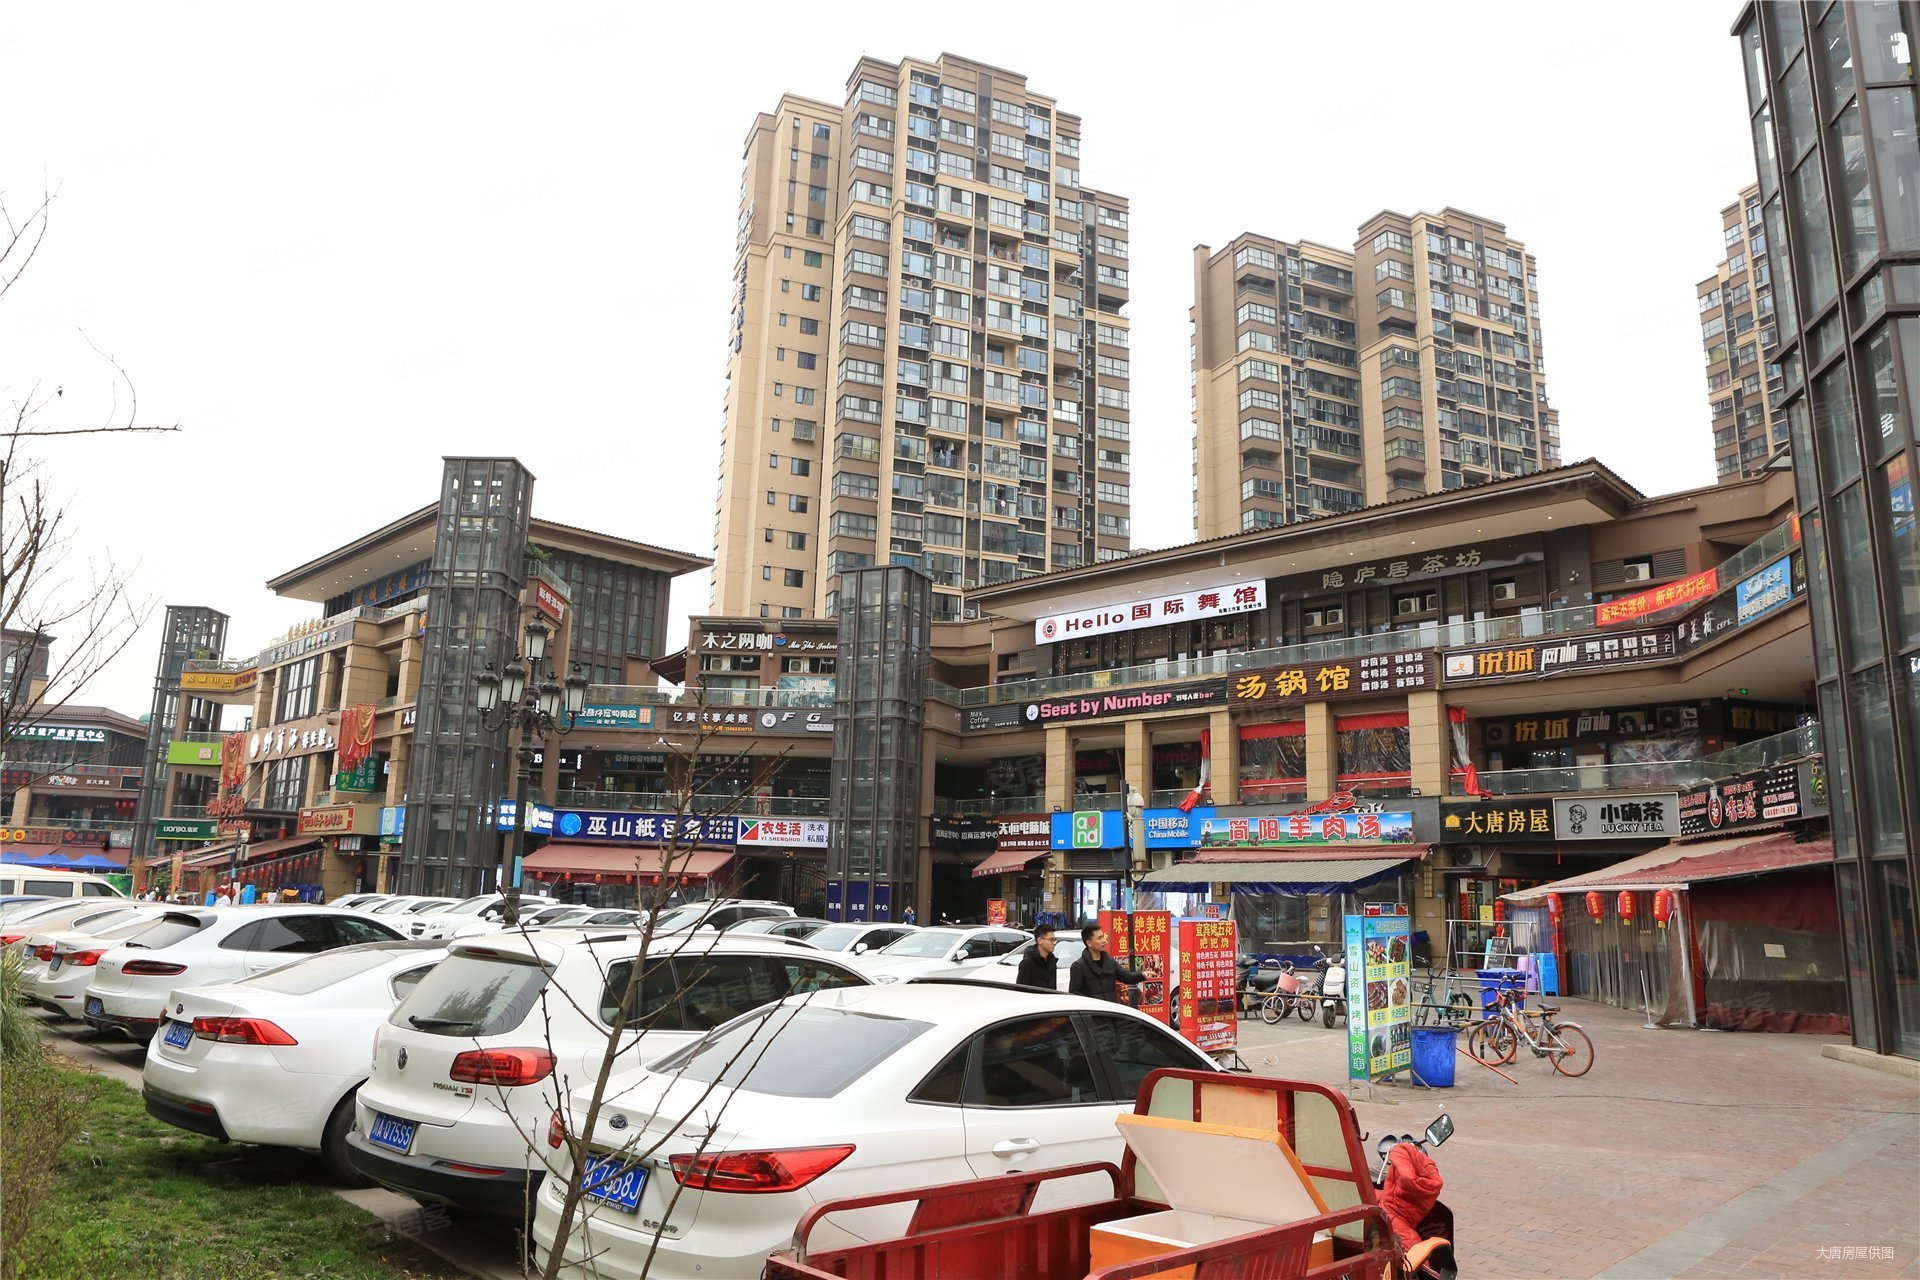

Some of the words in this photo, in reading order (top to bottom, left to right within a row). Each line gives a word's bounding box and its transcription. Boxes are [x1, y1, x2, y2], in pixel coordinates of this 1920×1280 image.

[1322, 549, 1482, 589] 隐庐居茶坊
[1065, 612, 1125, 632] Hello
[1132, 586, 1258, 622] 国际舞馆
[702, 632, 773, 650] 木之网咖
[1235, 665, 1350, 699] 汤锅馆
[1040, 702, 1077, 718] Seat
[1080, 701, 1100, 715] by
[1103, 692, 1173, 711] Number
[1148, 816, 1189, 830] 中国移动
[1464, 808, 1550, 835] 大唐房屋
[1600, 801, 1664, 824] 小确茶
[761, 821, 802, 836] 衣生活
[807, 823, 825, 832] 洗衣
[1148, 830, 1167, 839] China
[1167, 830, 1189, 838] Mobile
[1228, 814, 1382, 842] 简阳羊肉汤
[1601, 822, 1640, 834] LUCKY
[1641, 822, 1664, 832] TEA
[874, 903, 888, 911] 中心
[1195, 921, 1233, 937] 宜宾烤五花
[1181, 951, 1192, 1018] 欢迎光临
[1348, 945, 1365, 1071] 雪山资格烤羊肉串
